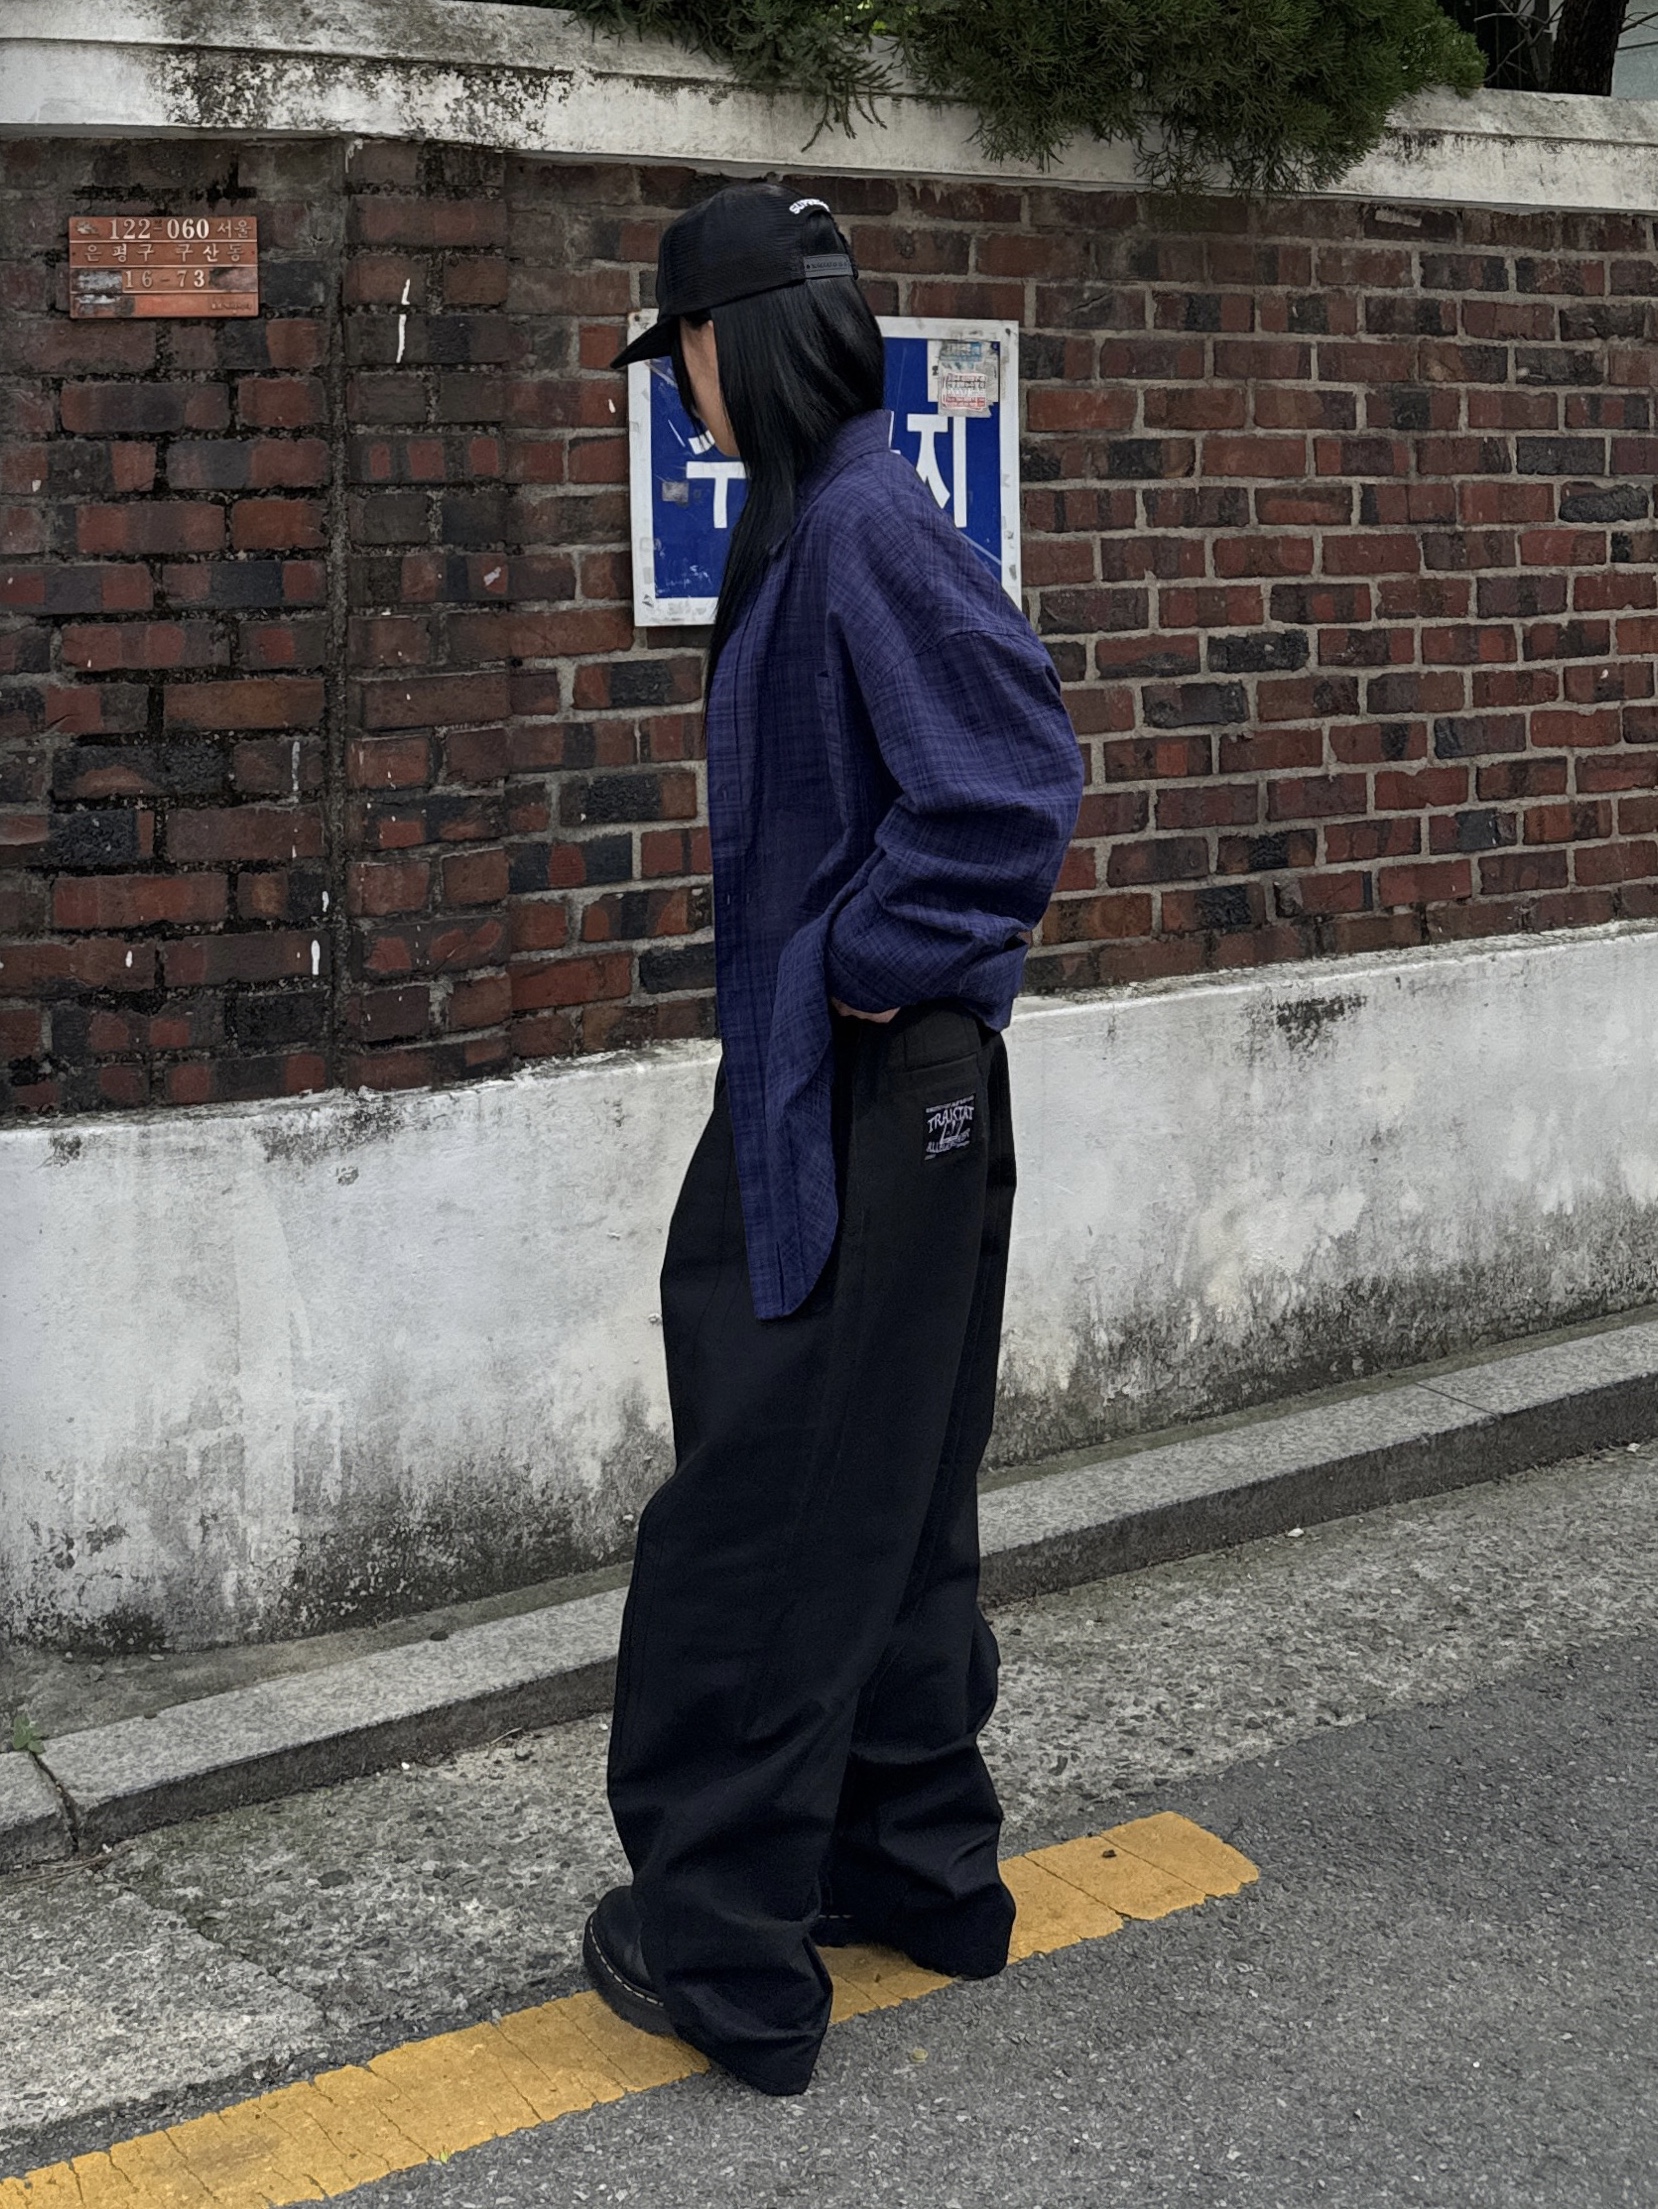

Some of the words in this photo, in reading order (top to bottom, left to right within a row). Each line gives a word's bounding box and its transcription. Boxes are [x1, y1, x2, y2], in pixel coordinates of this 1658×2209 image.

[109, 218, 210, 239] 122-060
[216, 219, 252, 239] 서울
[84, 243, 155, 263] 은평구
[175, 243, 244, 263] 구산동
[124, 269, 205, 288] 16-73
